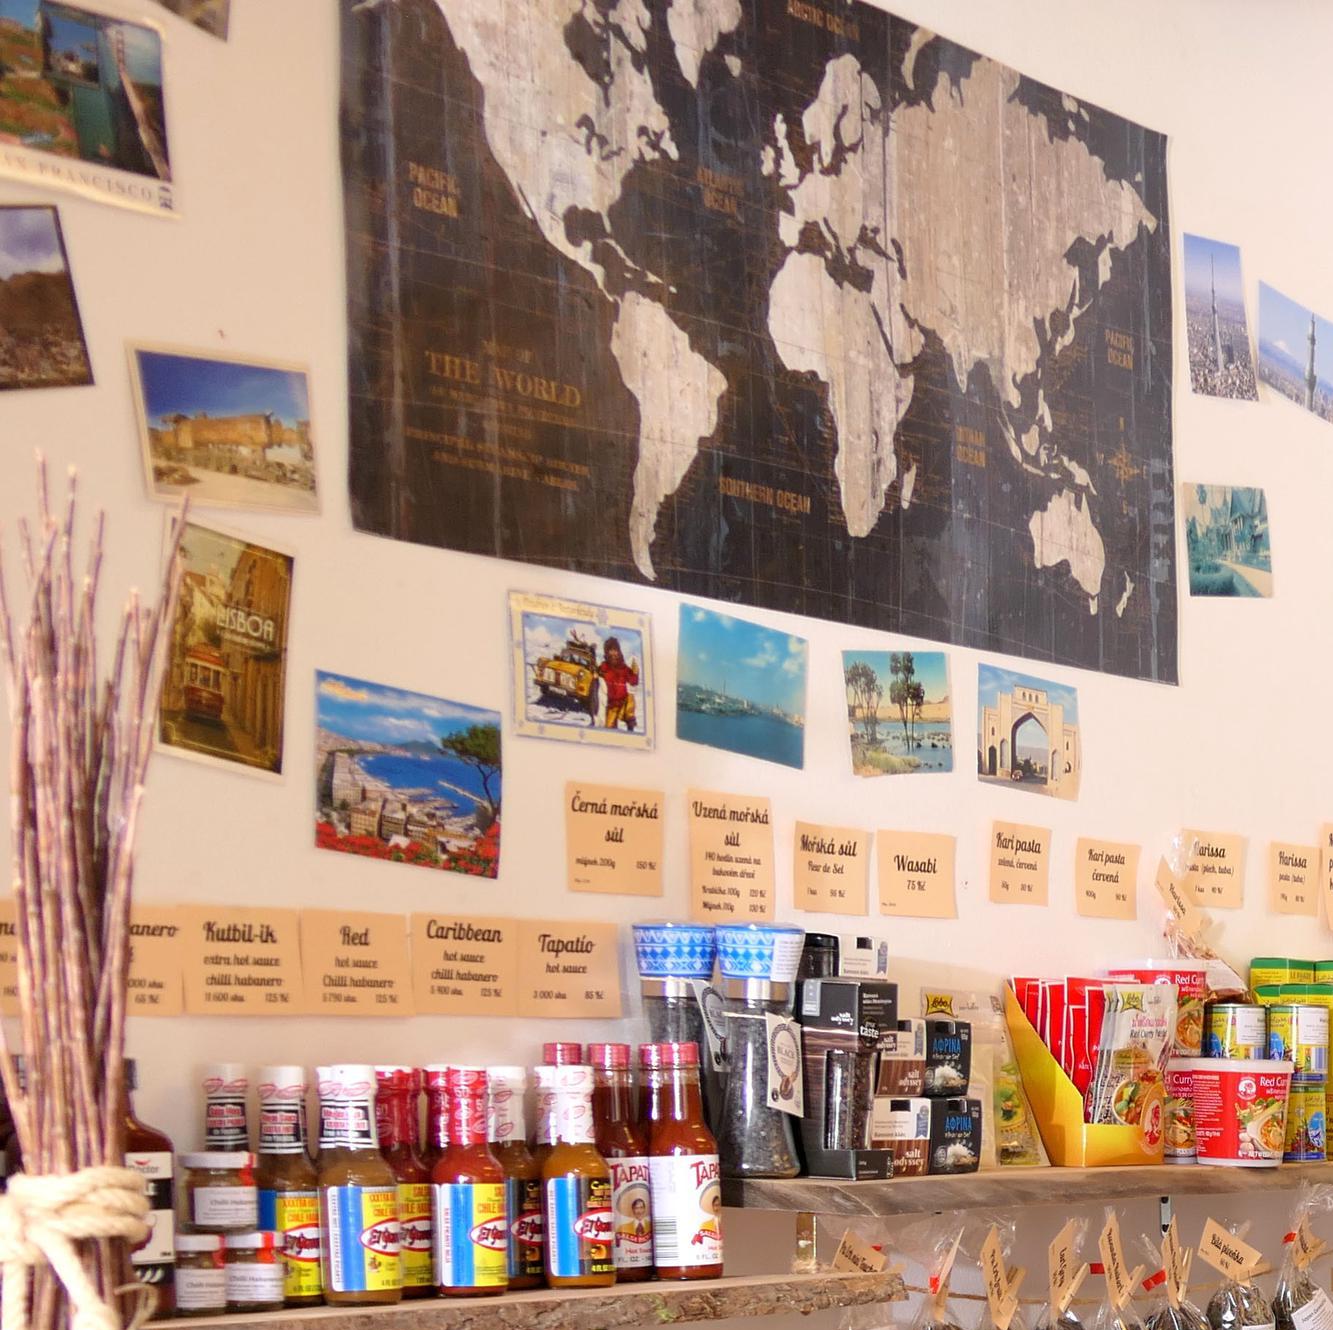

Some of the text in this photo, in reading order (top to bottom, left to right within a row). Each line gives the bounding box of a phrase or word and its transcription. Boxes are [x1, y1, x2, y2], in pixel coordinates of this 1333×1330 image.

[426, 351, 582, 408] THE WORLD
[775, 485, 811, 514] OCEAN
[214, 604, 276, 643] LISBOA
[571, 790, 659, 820] Černá mořská
[692, 801, 769, 825] Uzená mořská
[604, 827, 625, 844] sůl
[724, 832, 741, 848] sůl
[996, 832, 1042, 856] Kari pasta
[800, 834, 858, 858] Mořská sůl
[893, 854, 938, 875] Wasabi
[1088, 848, 1126, 868] Kari pasta
[1279, 850, 1308, 870] Harissa
[1092, 869, 1120, 884] červená
[203, 920, 278, 945] Kutbil-ik
[339, 925, 371, 947] Red
[426, 919, 504, 944] Caribbean
[537, 933, 597, 958] Tapatío
[232, 954, 281, 968] hot sauce
[334, 957, 379, 969] hot sauce
[443, 950, 486, 964] hot sauce
[430, 968, 499, 983] chilli habanero
[545, 962, 588, 974] hot sauce
[205, 973, 283, 988] chilli habanero
[322, 974, 394, 989] Chilli habanero
[1175, 974, 1190, 985] Red
[1173, 1075, 1193, 1088] Curry
[1260, 1077, 1275, 1087] Red
[905, 1150, 921, 1159] salt
